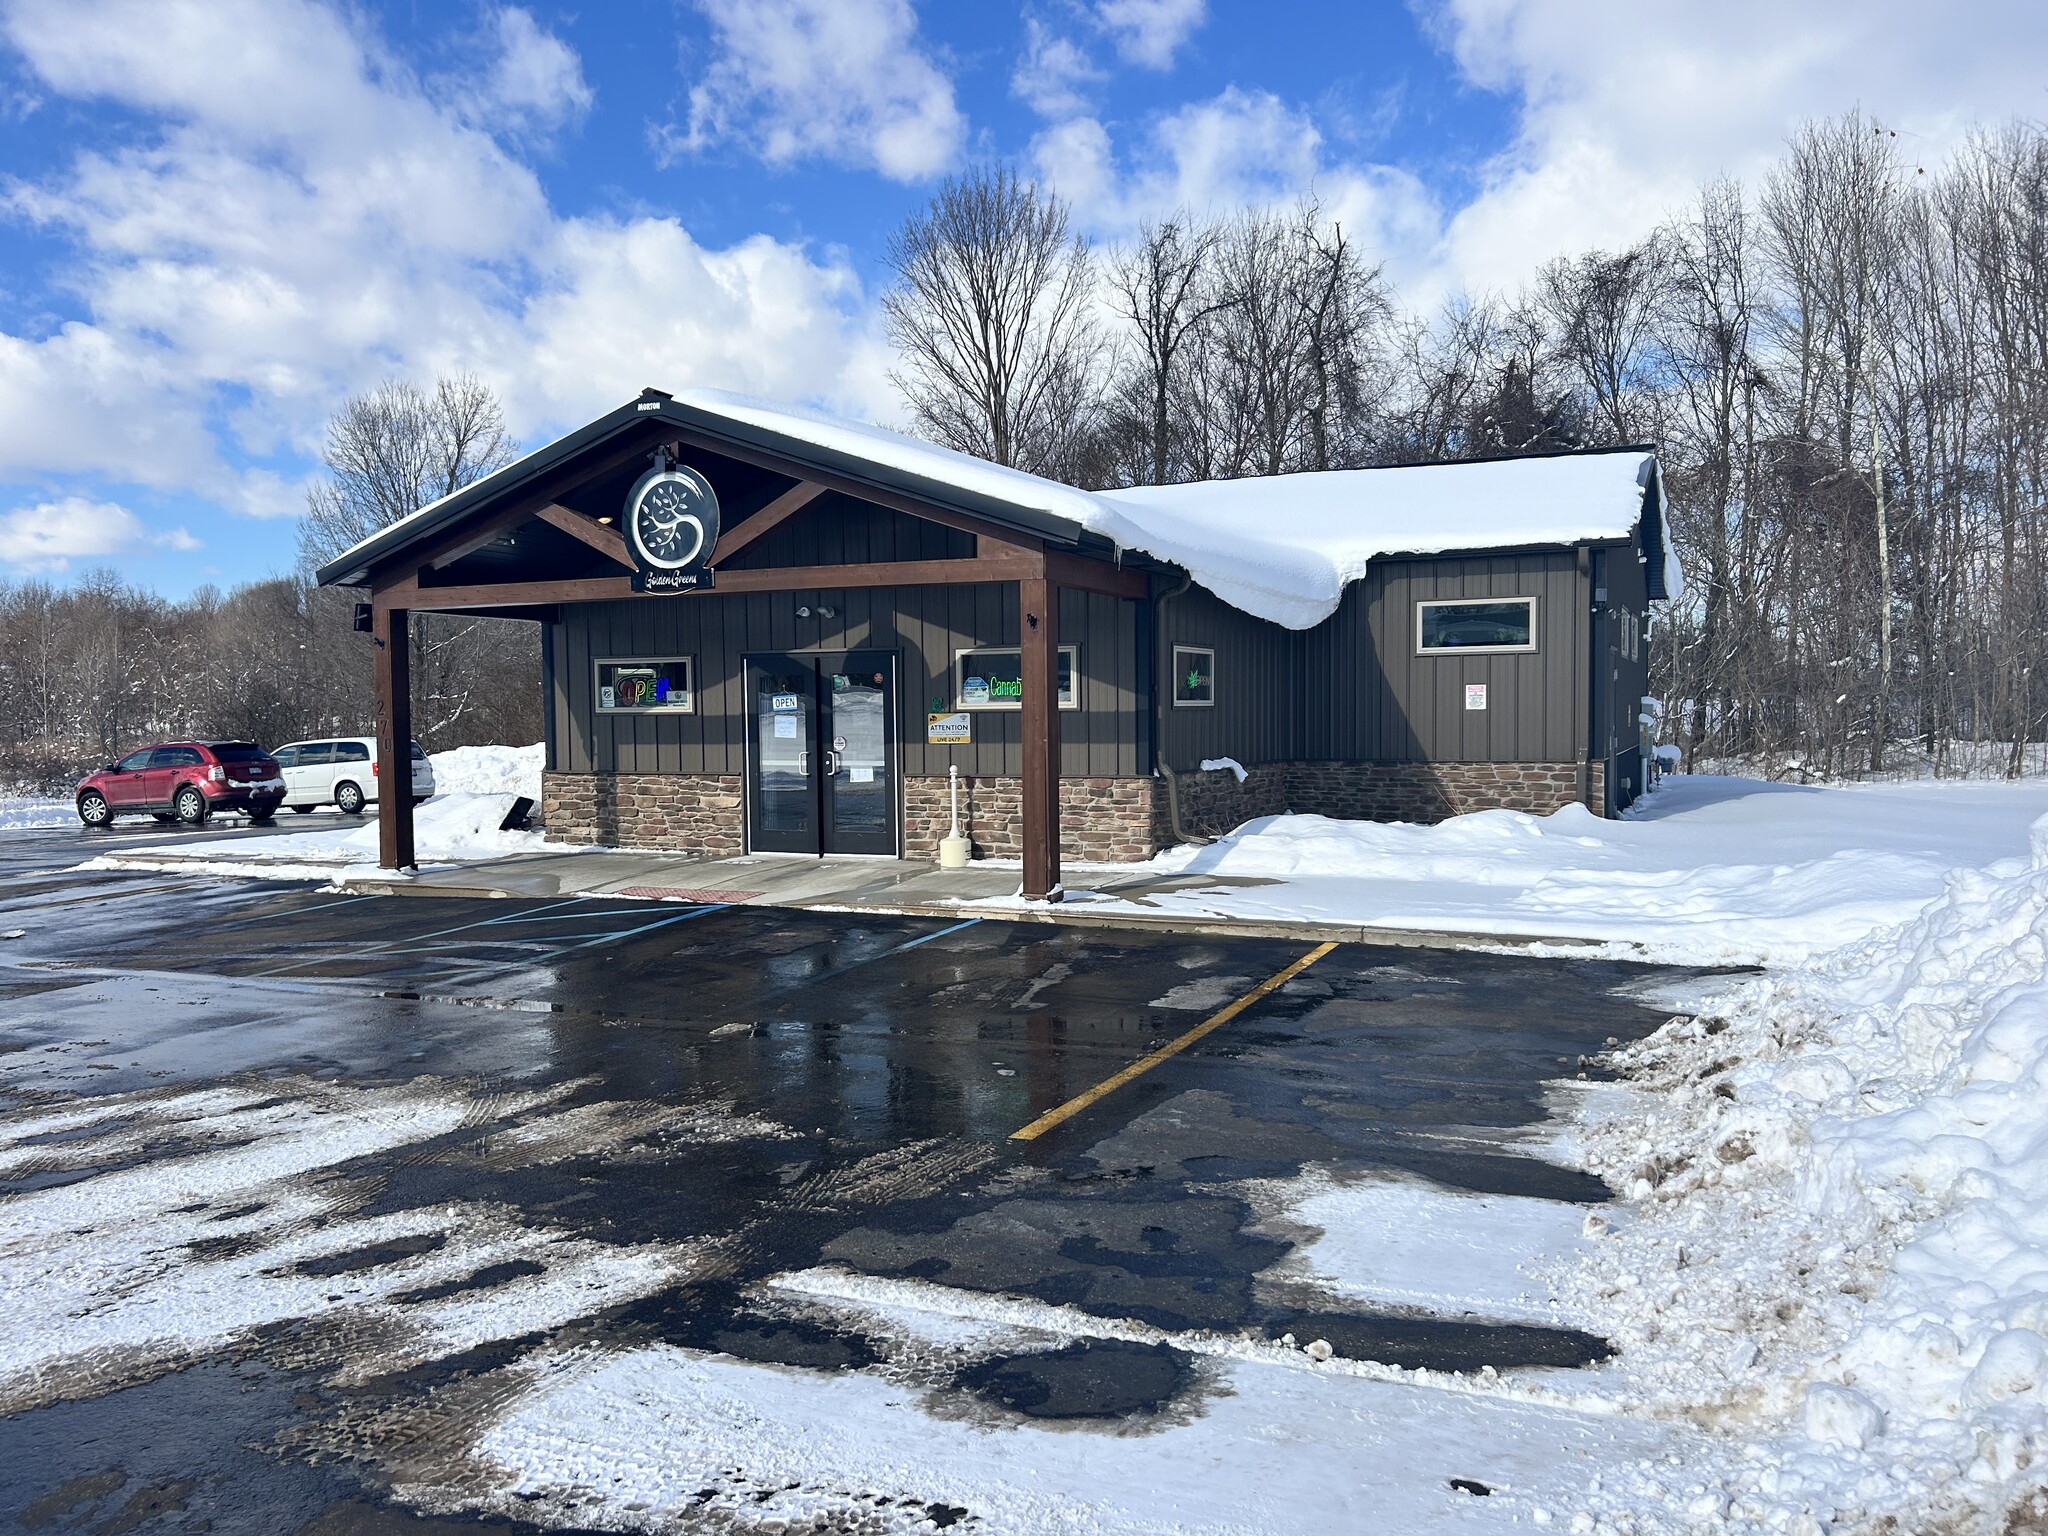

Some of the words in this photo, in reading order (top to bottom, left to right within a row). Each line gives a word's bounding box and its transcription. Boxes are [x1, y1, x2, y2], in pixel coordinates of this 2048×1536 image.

[637, 402, 660, 411] MORTON
[622, 677, 669, 705] OPEN
[990, 676, 1022, 696] Cannab
[775, 697, 795, 708] OPEN
